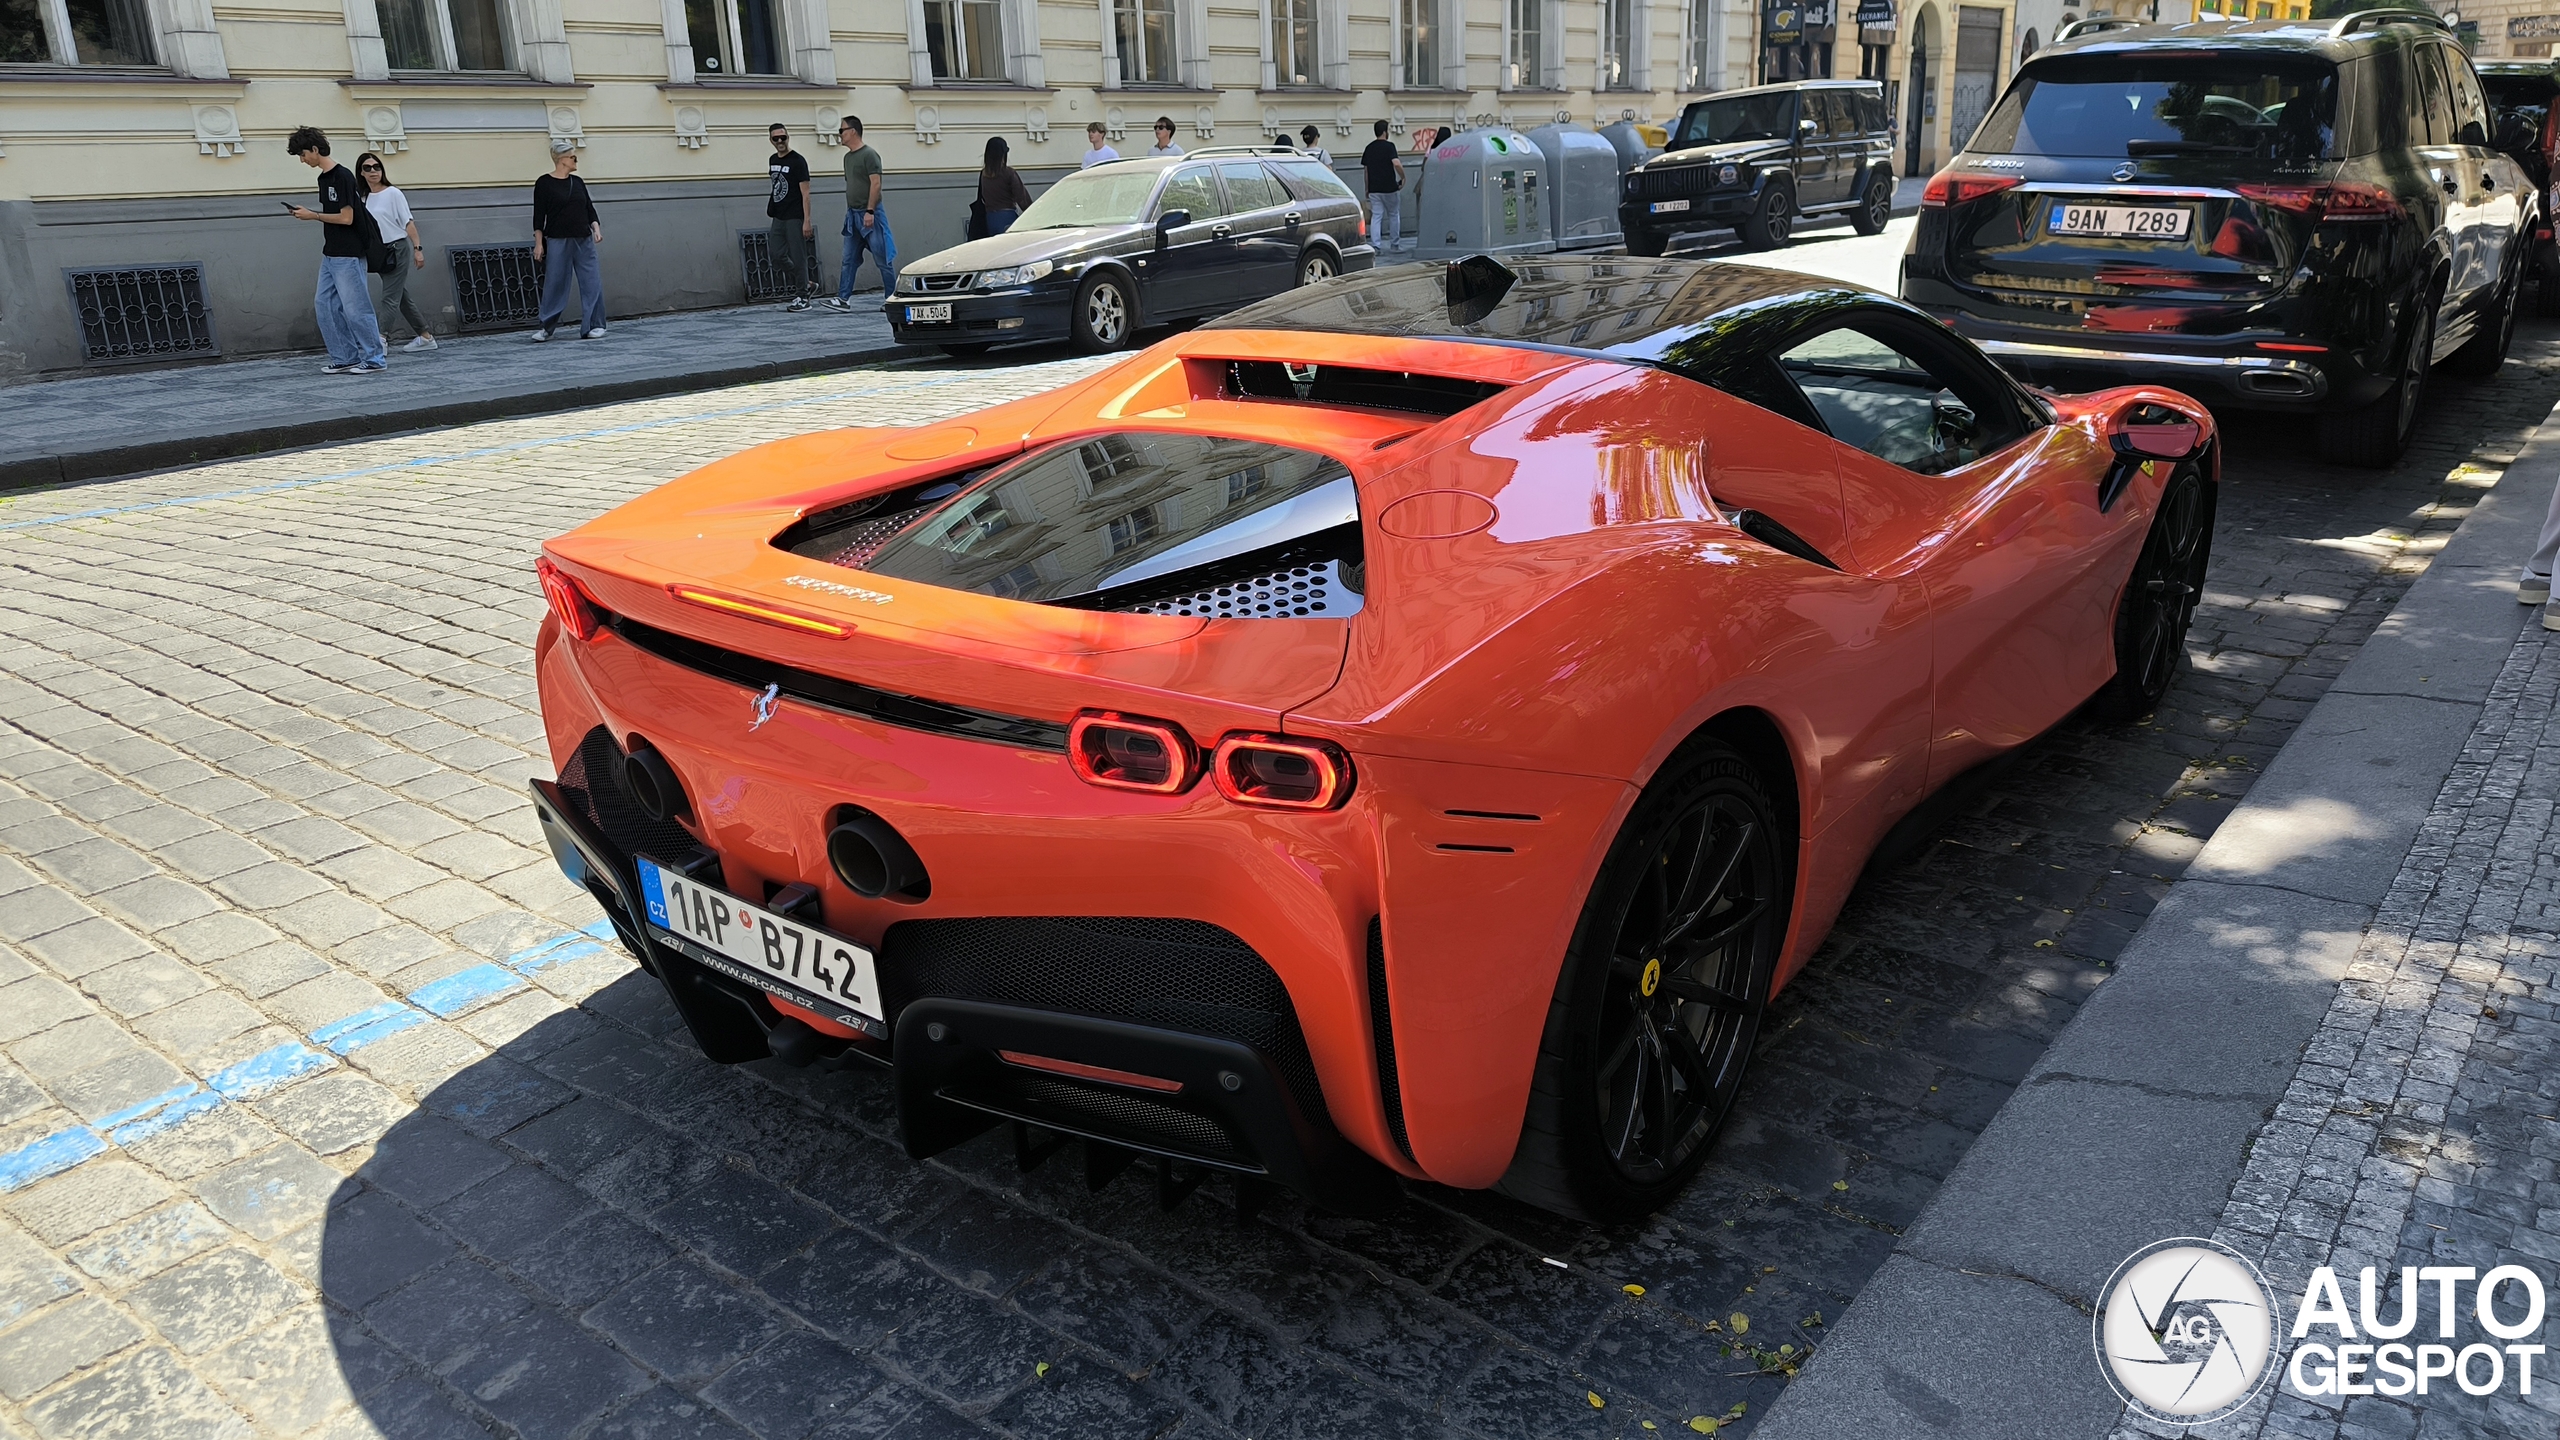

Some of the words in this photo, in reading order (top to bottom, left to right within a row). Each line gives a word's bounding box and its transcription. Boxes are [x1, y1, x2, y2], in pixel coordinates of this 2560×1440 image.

[2067, 209, 2108, 230] 9AN
[2125, 210, 2179, 233] 1289
[1700, 760, 1765, 796] MICHELIN
[649, 901, 667, 919] CZ
[670, 880, 731, 947] 1AP
[759, 915, 862, 1004] B742
